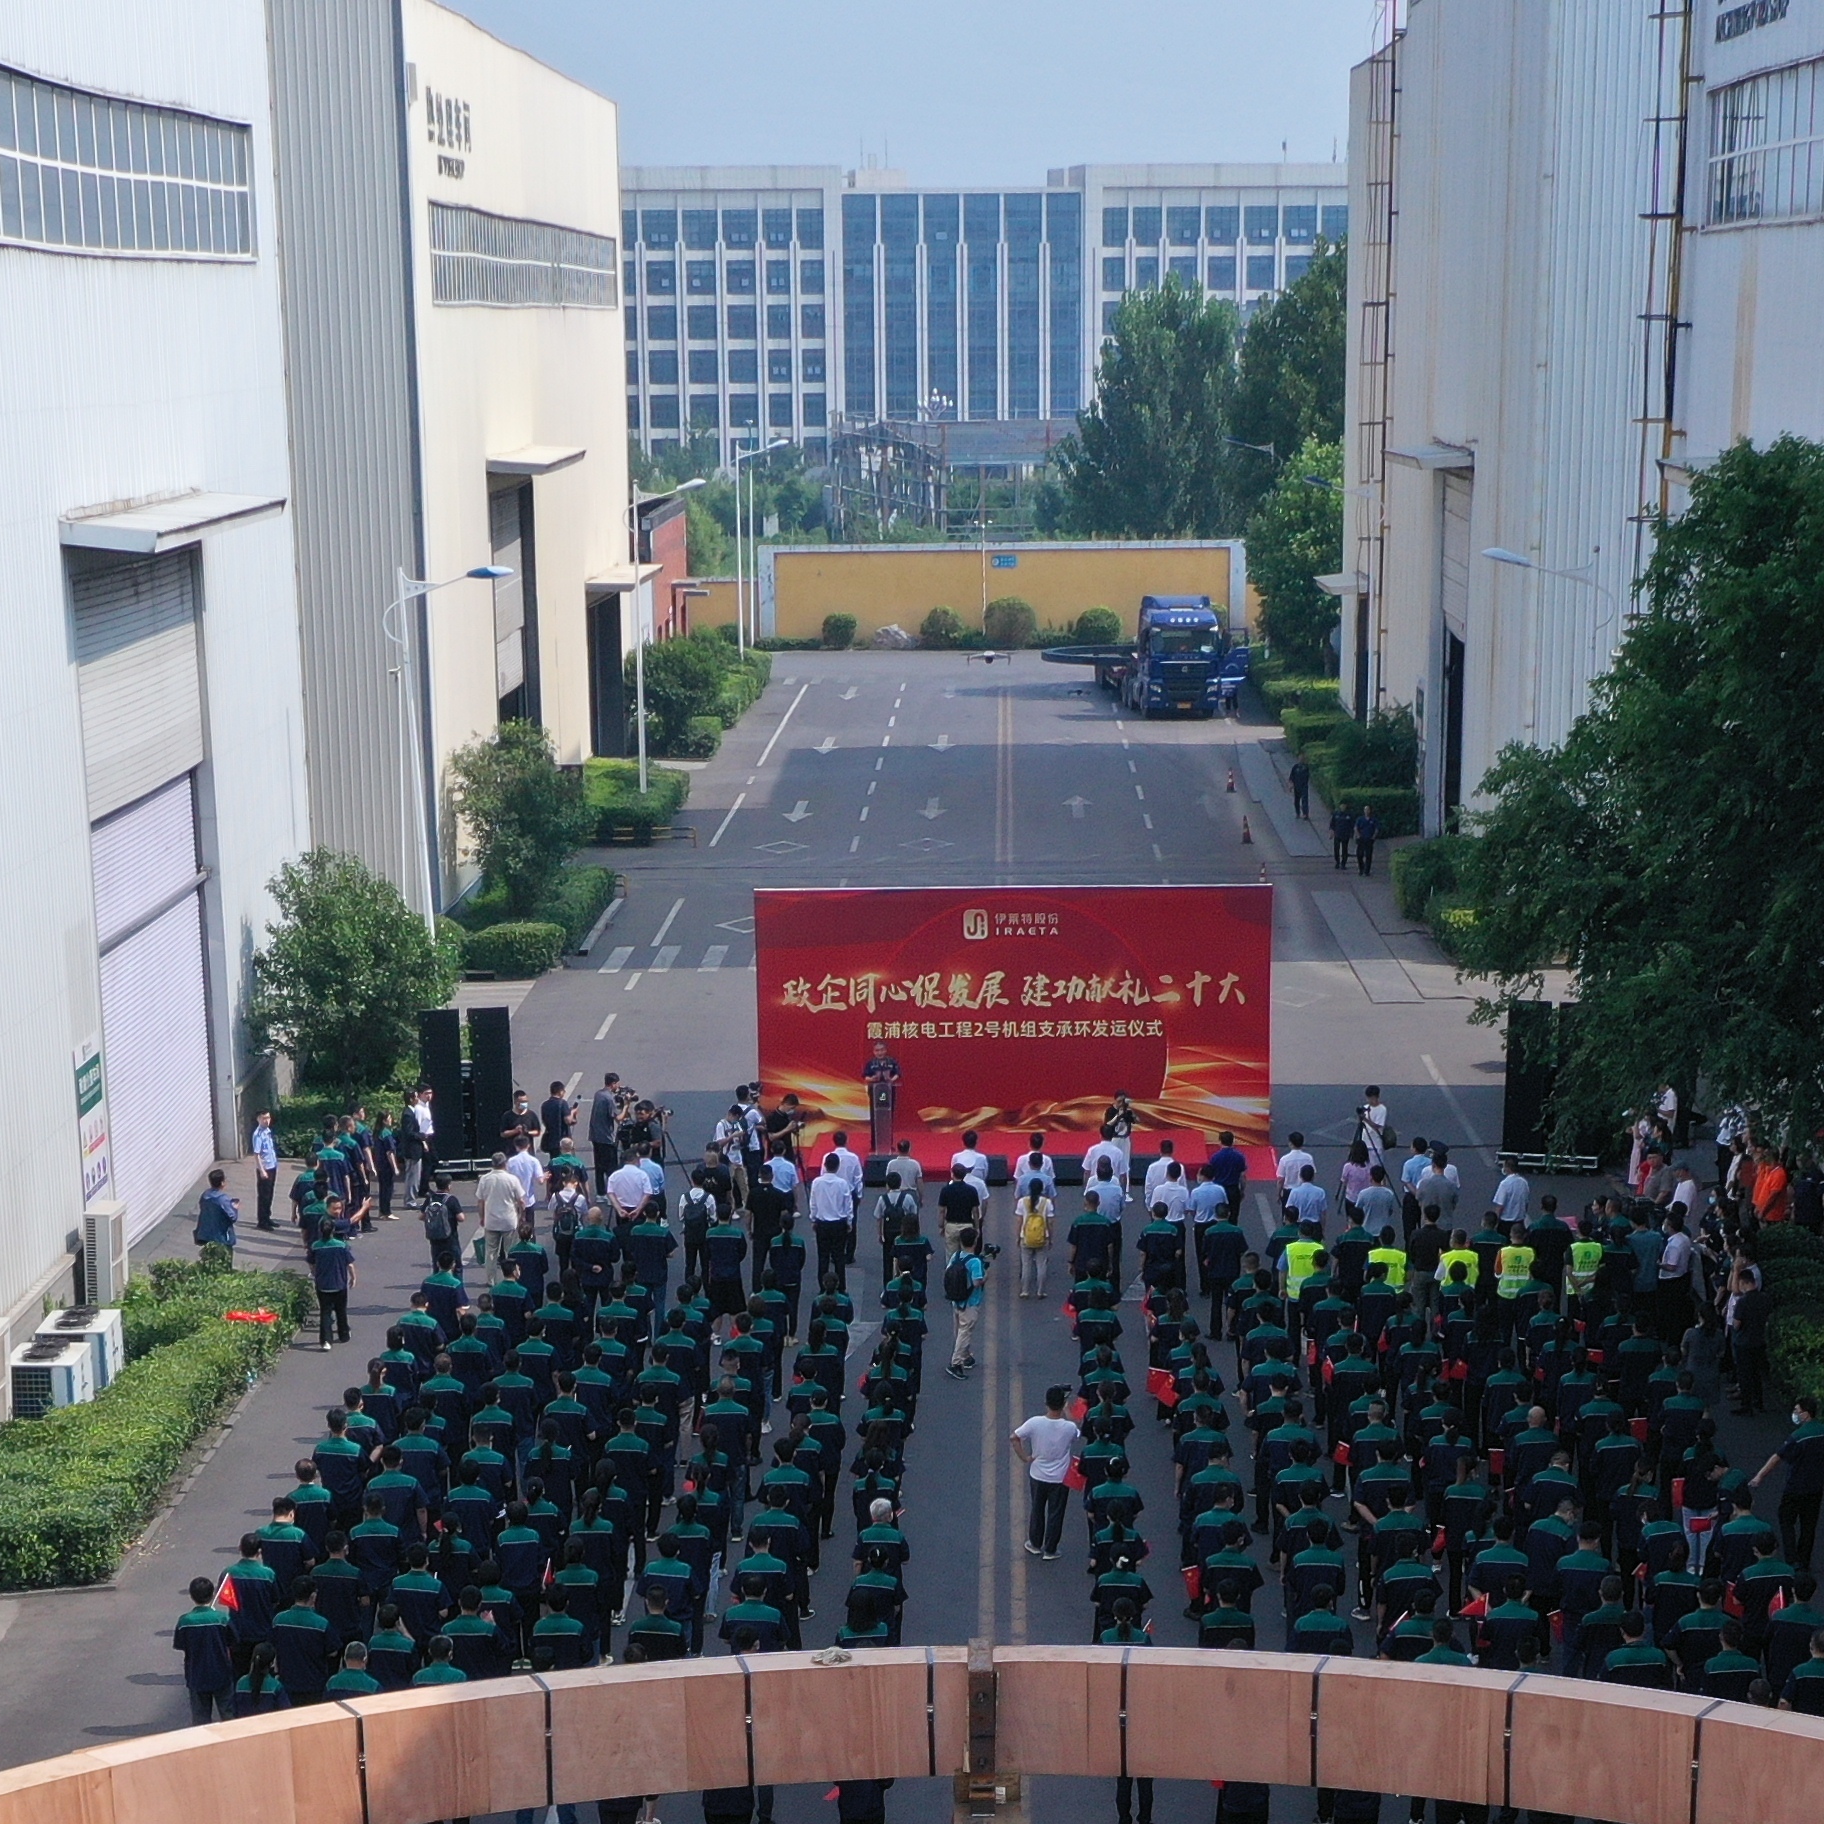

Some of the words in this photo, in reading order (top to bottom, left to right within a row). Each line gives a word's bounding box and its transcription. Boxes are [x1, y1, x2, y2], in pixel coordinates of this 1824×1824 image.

[994, 911, 1059, 925] 伊莱特股份
[995, 926, 1059, 936] IRAETA
[781, 970, 1010, 1014] 政企同心促发展
[1021, 969, 1246, 1008] 建功献礼二十大
[866, 1018, 1164, 1040] 霞浦核电工程2号机组支承环发运仪式
